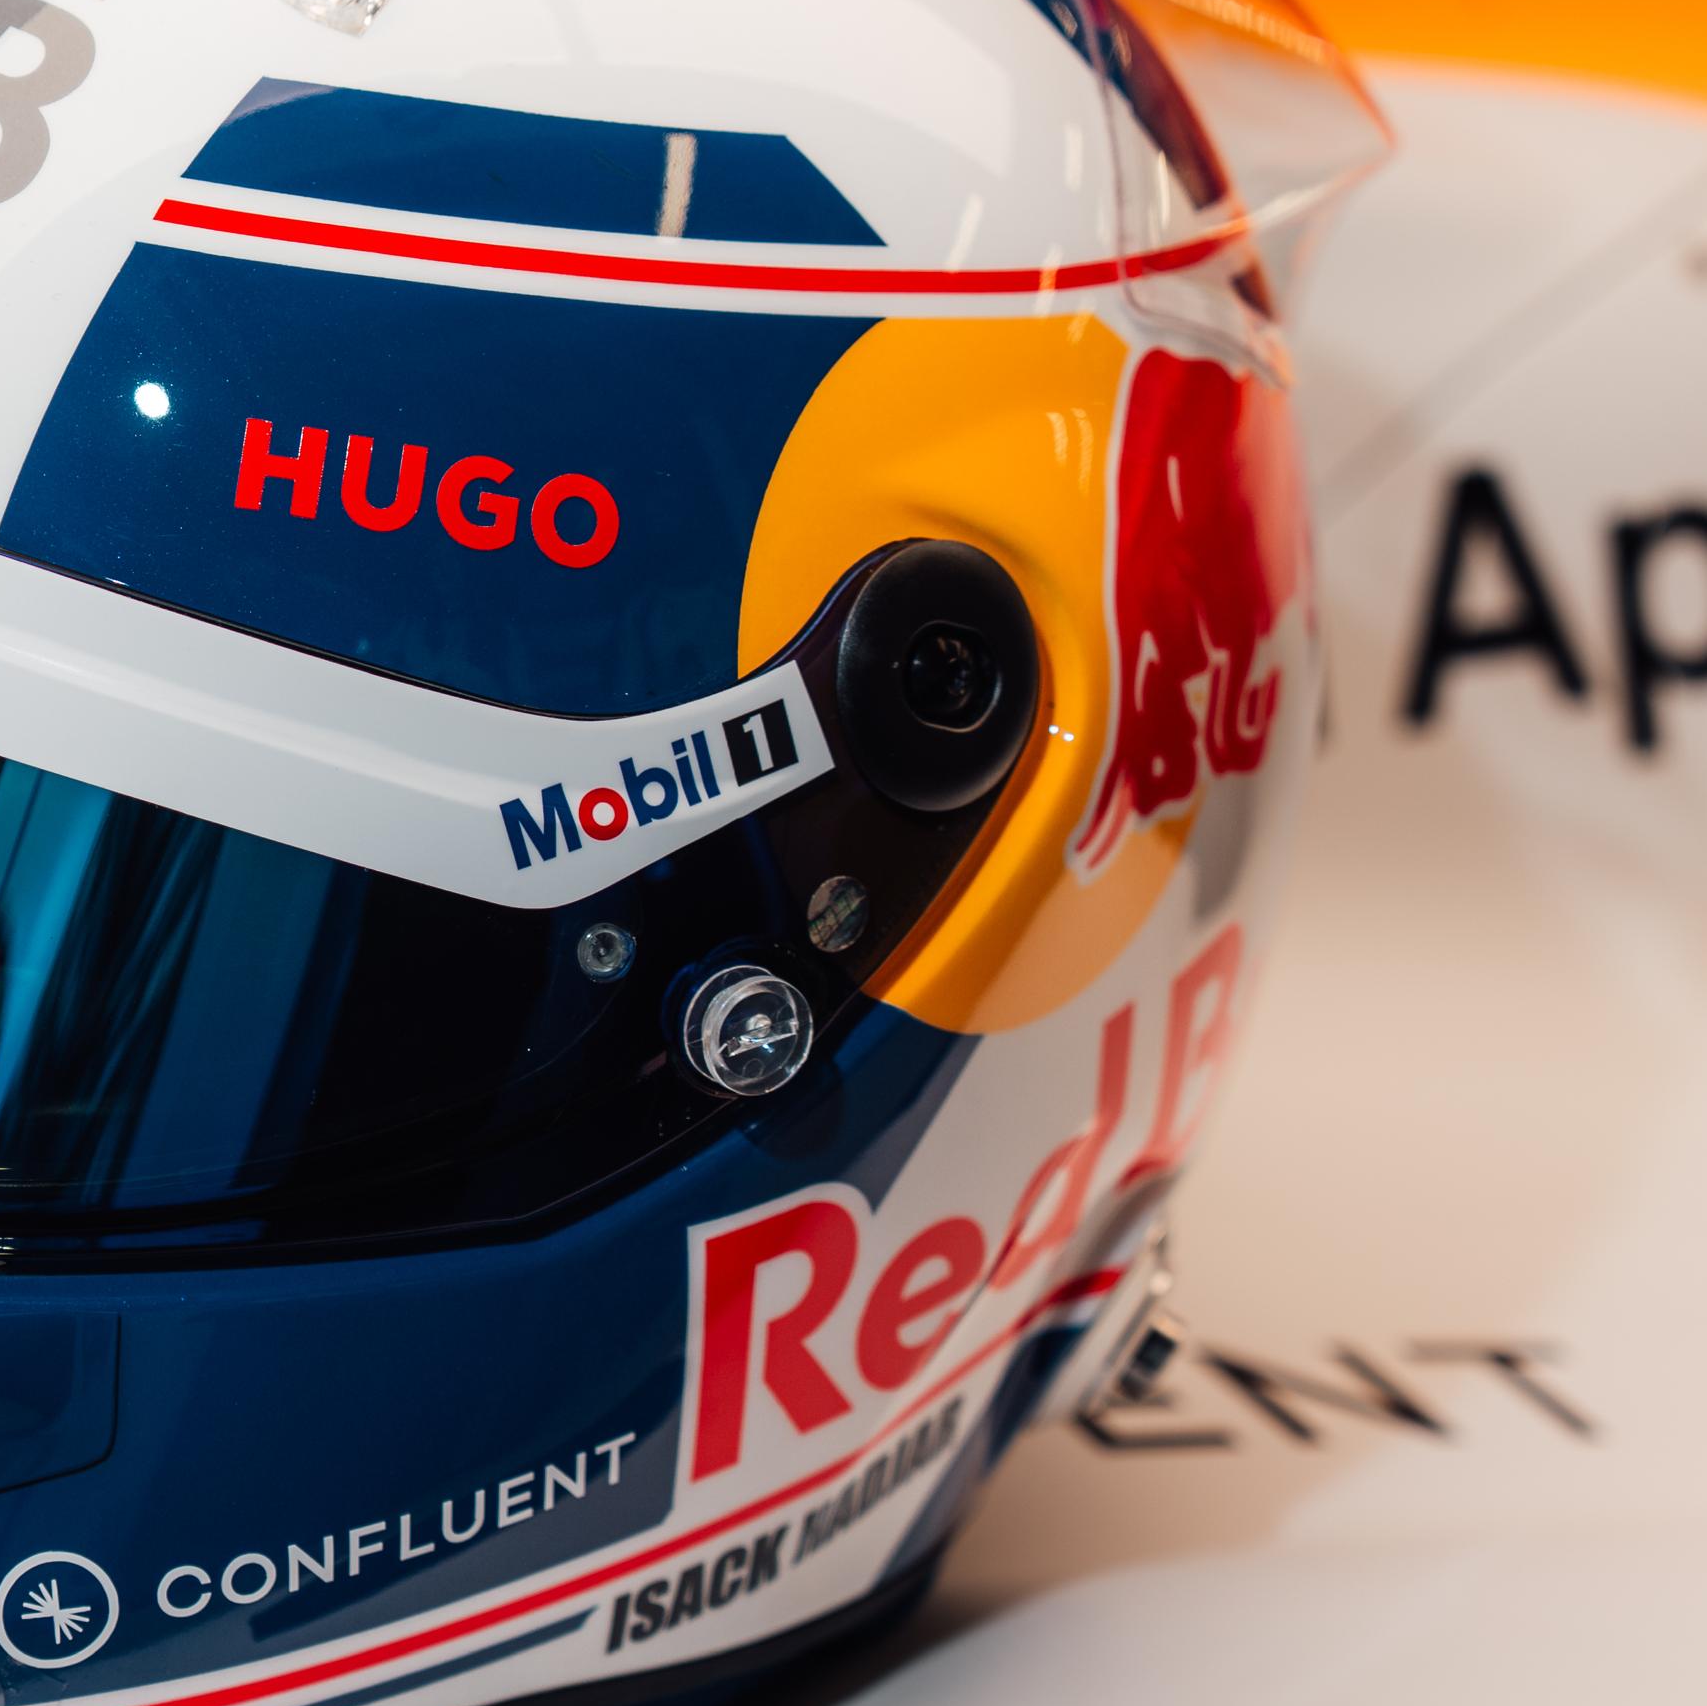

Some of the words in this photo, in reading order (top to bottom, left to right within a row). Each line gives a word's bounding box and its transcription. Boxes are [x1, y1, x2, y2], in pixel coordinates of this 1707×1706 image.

[233, 418, 620, 568] HUGO
[499, 730, 722, 870] Mobil
[690, 1000, 1136, 1487] Red
[156, 1432, 635, 1618] CONFLUENT
[606, 1522, 791, 1654] ISACK
